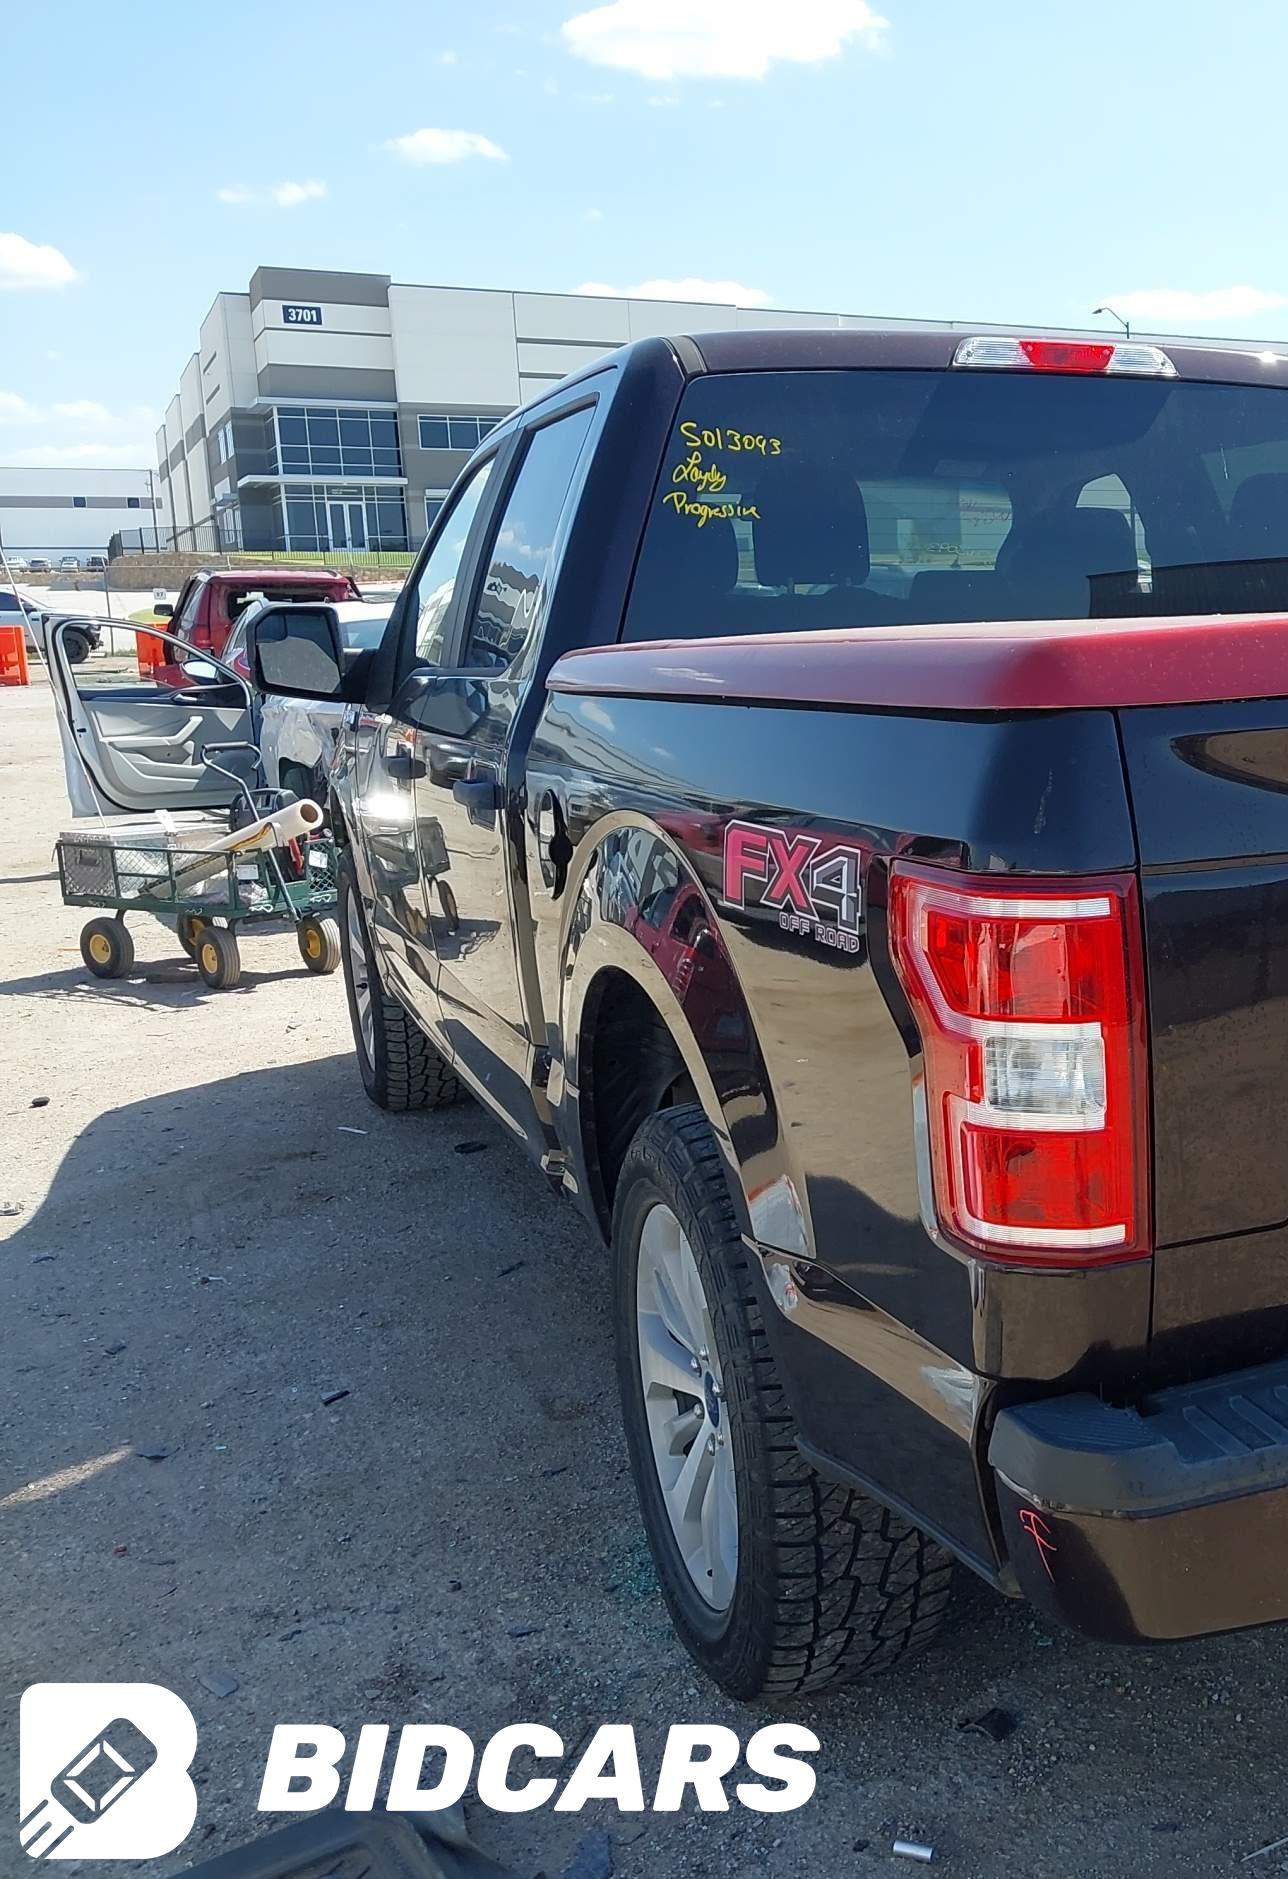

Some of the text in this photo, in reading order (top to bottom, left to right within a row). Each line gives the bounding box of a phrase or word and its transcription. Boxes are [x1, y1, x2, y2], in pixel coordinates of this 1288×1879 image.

[288, 308, 318, 322] 3701
[723, 819, 862, 935] FX4
[778, 911, 861, 954] OFF ROAD
